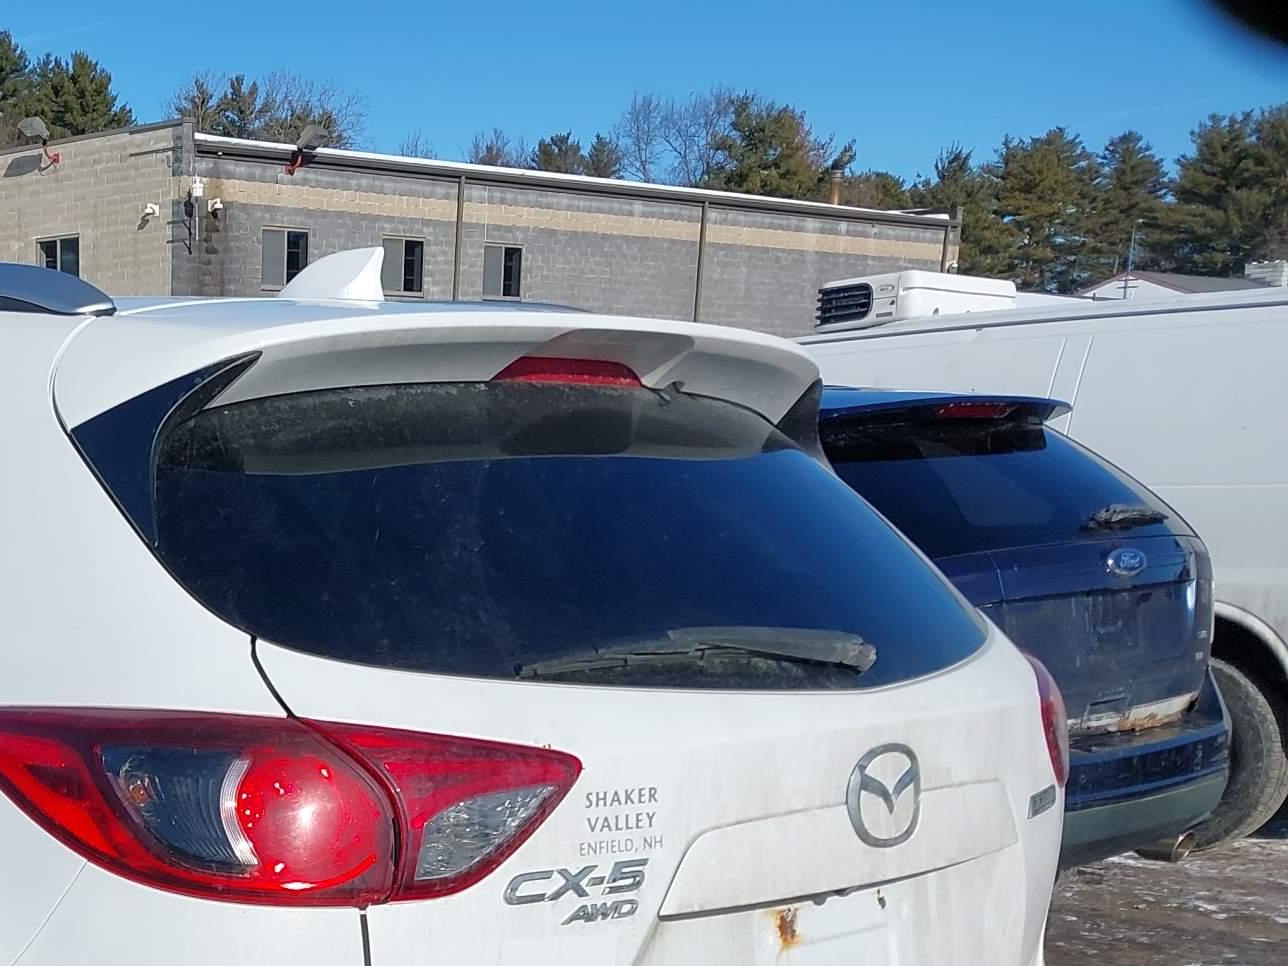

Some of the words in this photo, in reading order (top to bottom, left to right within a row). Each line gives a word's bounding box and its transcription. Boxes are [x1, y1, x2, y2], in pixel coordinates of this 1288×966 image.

[585, 786, 658, 809] SHAKER
[587, 811, 656, 832] VALLEY
[579, 838, 638, 857] ENFIELD,
[643, 834, 663, 850] NH
[503, 858, 650, 906] CX-5
[560, 899, 639, 925] AWD
